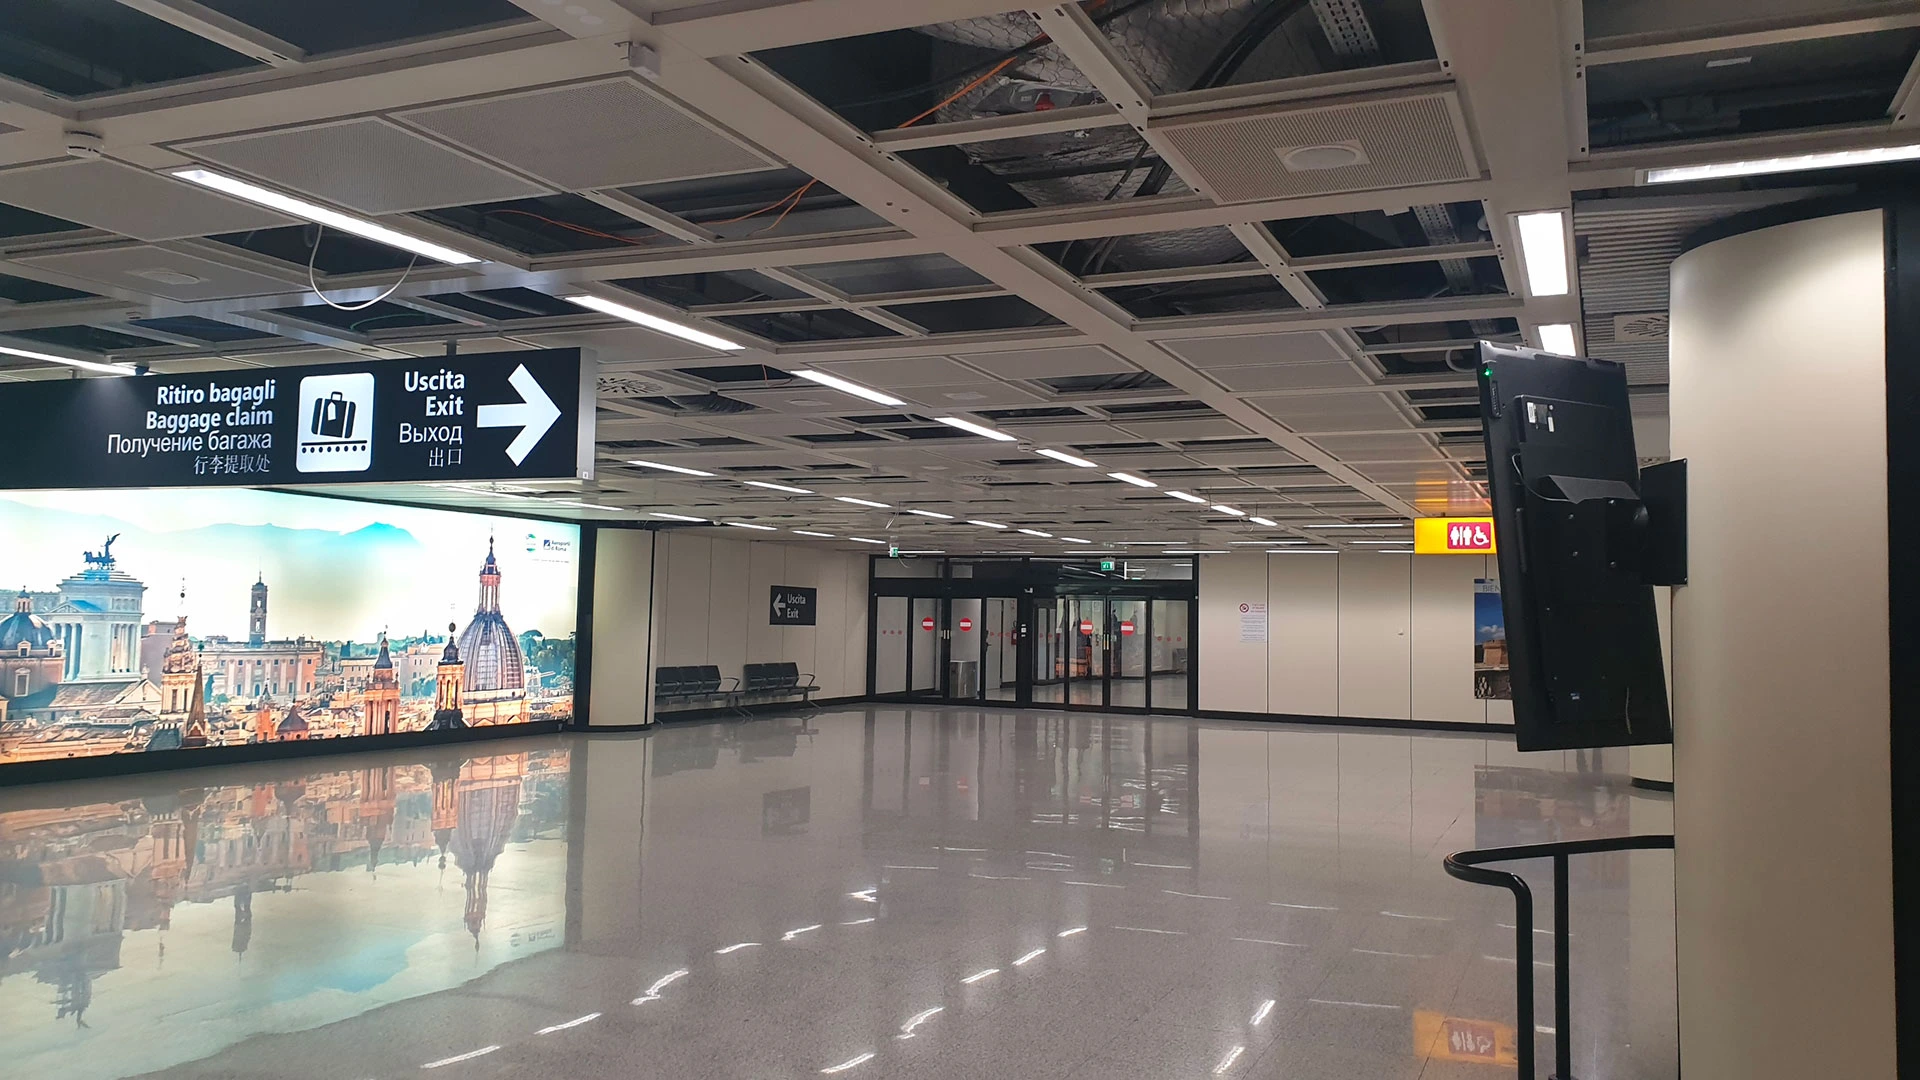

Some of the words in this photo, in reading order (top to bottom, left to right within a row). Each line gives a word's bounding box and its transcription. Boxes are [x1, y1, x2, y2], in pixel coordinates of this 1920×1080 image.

[404, 368, 465, 392] Uscita
[157, 384, 204, 405] Ritiro
[209, 379, 276, 407] bagagli
[425, 394, 464, 416] Exit
[146, 410, 221, 434] Baggage
[225, 406, 273, 426] claim
[107, 433, 203, 458] Получение
[208, 430, 272, 451] багажа
[399, 422, 463, 446] Выход
[193, 454, 271, 475] 行李提取处
[428, 447, 462, 468] 出口
[787, 593, 806, 604] Uscita
[787, 608, 798, 618] Exit
